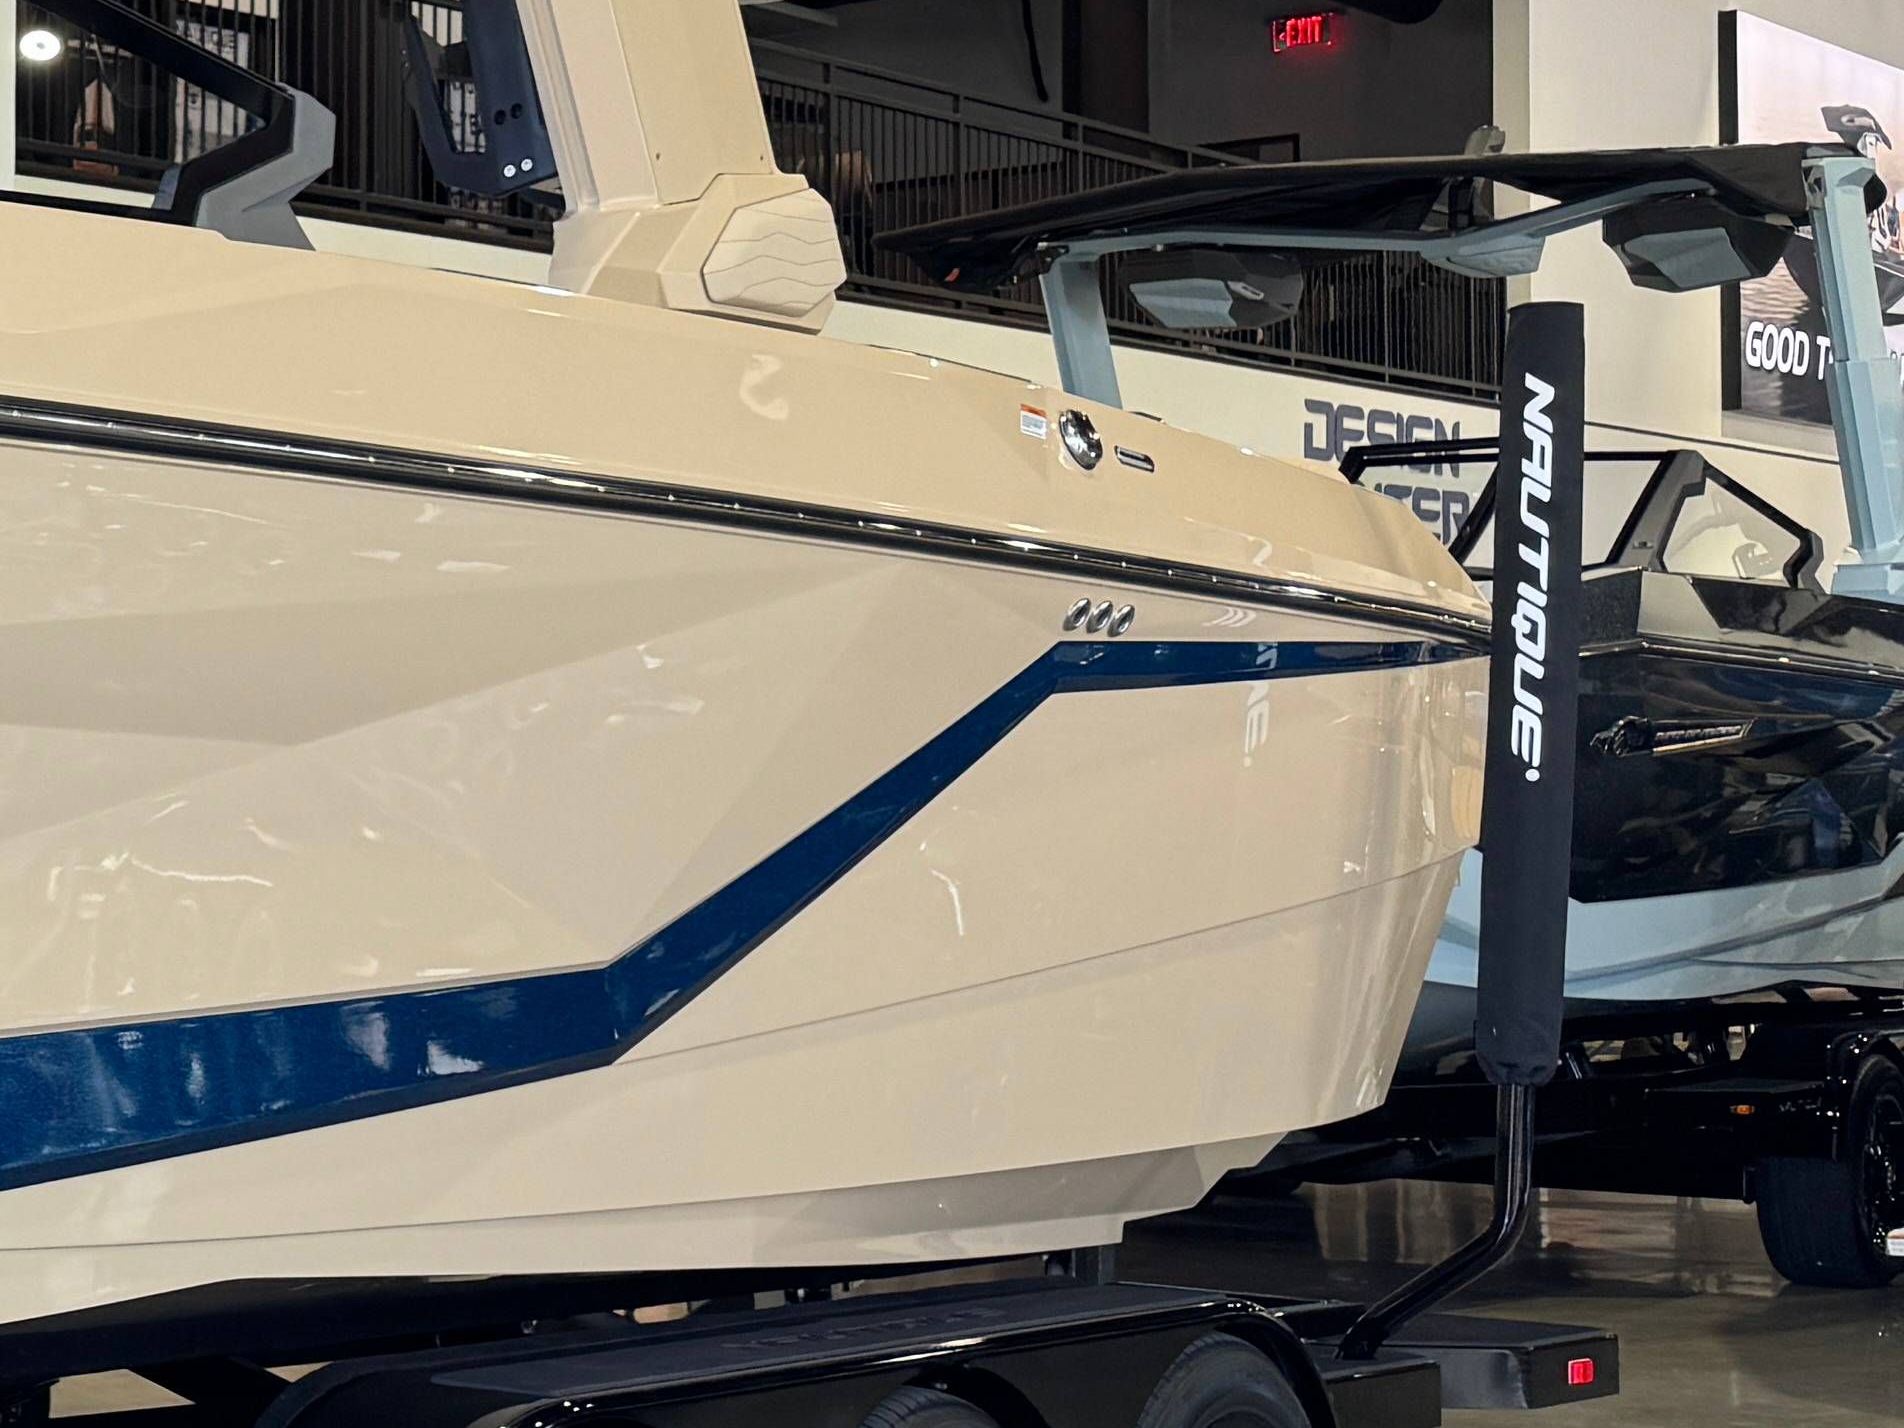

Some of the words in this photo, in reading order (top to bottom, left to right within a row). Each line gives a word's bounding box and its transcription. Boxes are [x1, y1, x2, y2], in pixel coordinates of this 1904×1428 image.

[1286, 15, 1322, 47] EXIT
[1745, 321, 1809, 377] GOOD
[1511, 372, 1555, 768] NAUTIQUE
